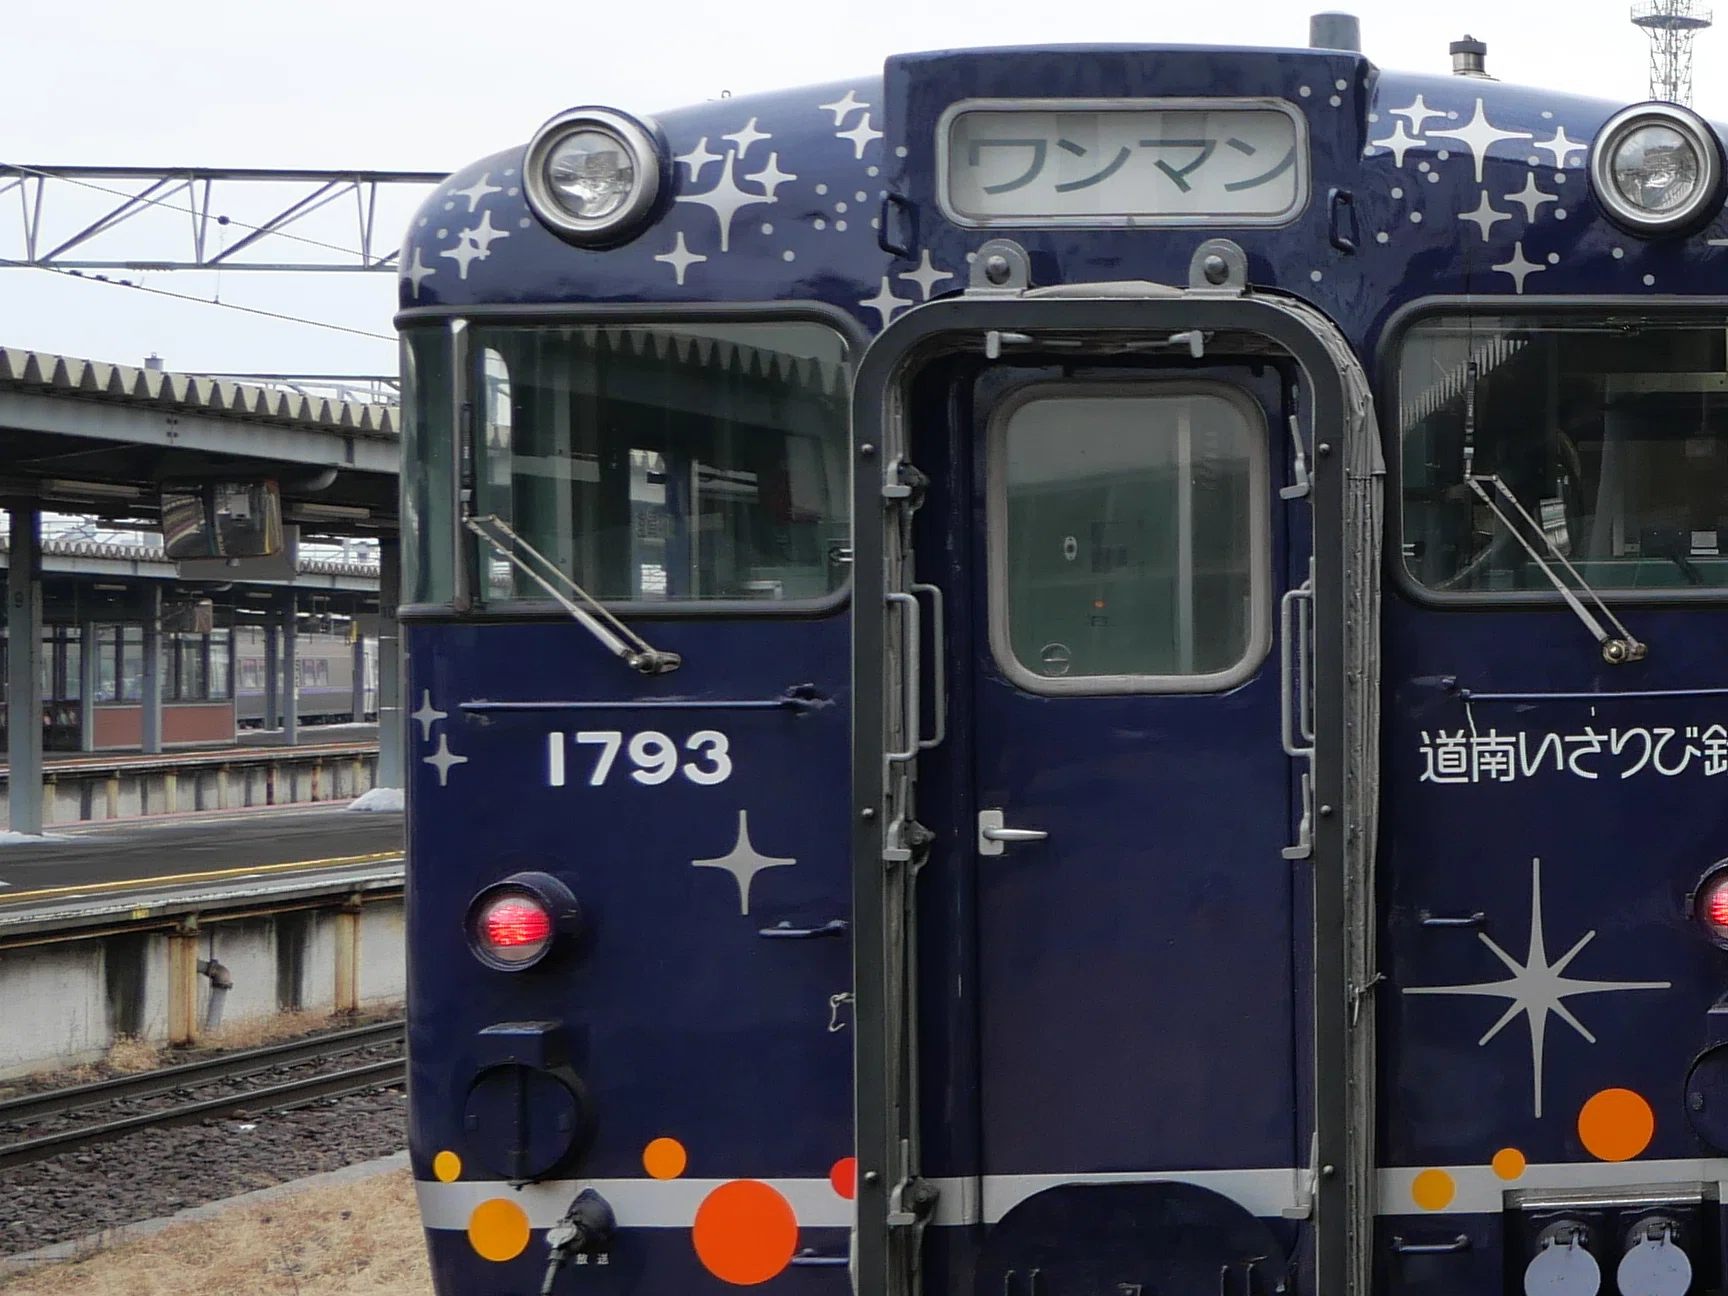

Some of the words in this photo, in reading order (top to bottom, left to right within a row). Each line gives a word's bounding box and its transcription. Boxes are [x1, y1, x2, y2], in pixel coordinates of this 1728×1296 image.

[968, 137, 1295, 195] ワンマン
[549, 730, 732, 786] 1793
